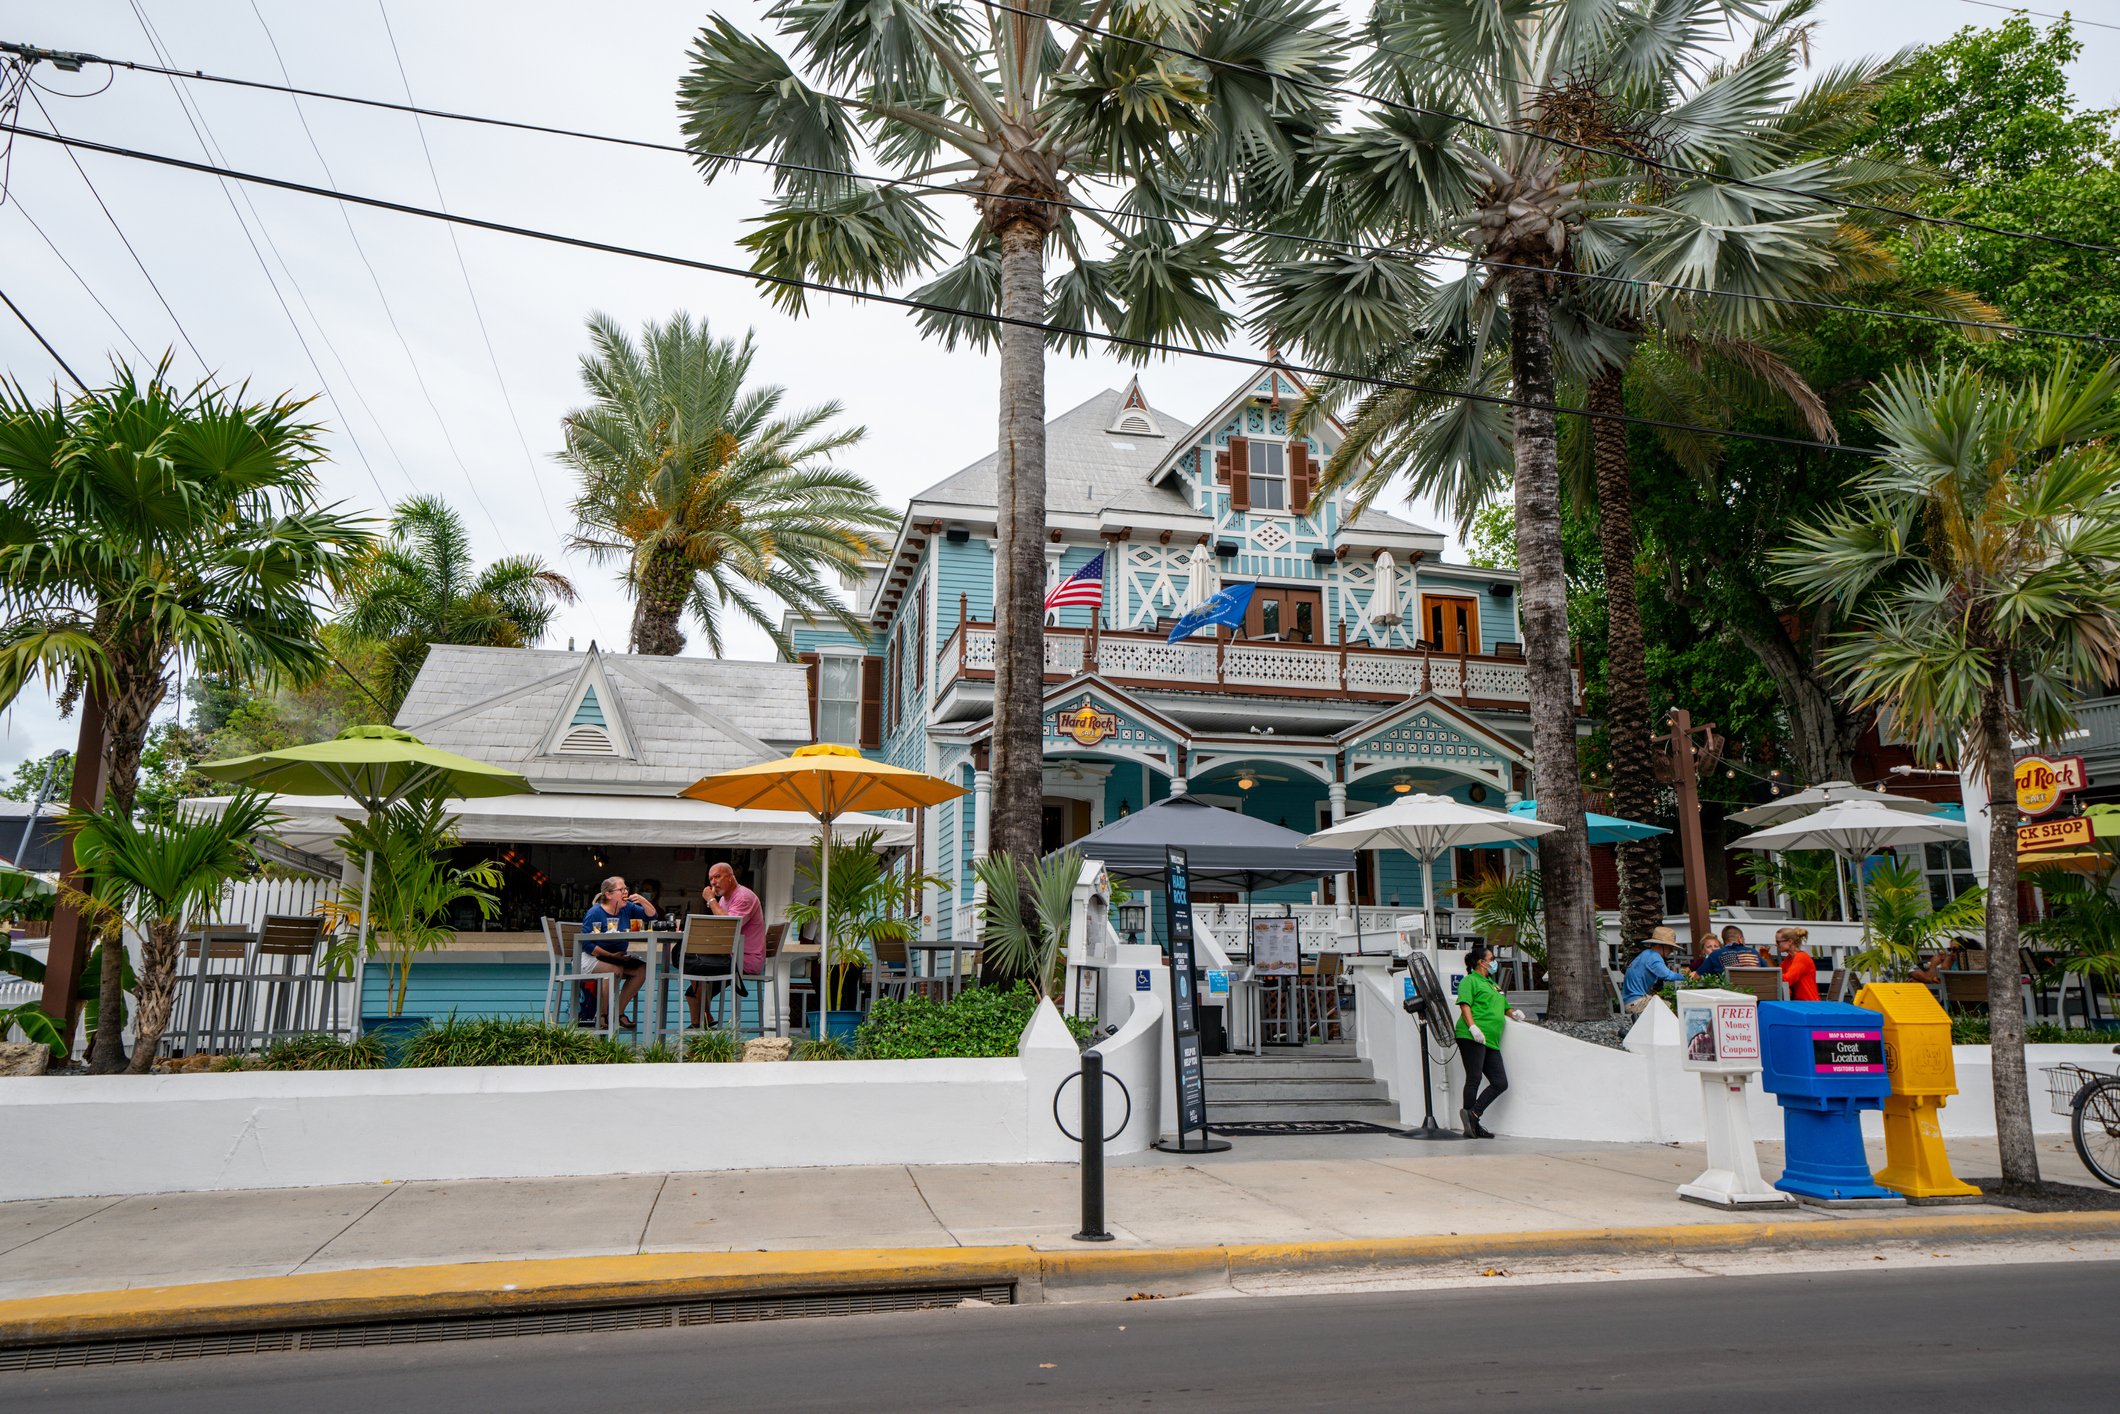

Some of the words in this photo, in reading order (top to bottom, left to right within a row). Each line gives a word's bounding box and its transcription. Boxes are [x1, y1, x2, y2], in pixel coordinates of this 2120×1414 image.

[1061, 714, 1088, 727] Hard
[1088, 716, 1113, 732] Rock
[2015, 770, 2032, 790] rd
[2034, 764, 2075, 790] Rock
[2024, 793, 2047, 804] CAFE
[2017, 827, 2039, 840] CK
[2042, 821, 2083, 837] SHOP
[1172, 875, 1186, 890] HARD
[1173, 890, 1187, 905] ROCK
[1721, 1008, 1753, 1019] FREE
[1724, 1020, 1751, 1031] Money
[1725, 1033, 1752, 1042] Saving
[1722, 1045, 1756, 1055] Coupons
[1836, 1042, 1859, 1053] Great
[1831, 1052, 1868, 1063] Locations
